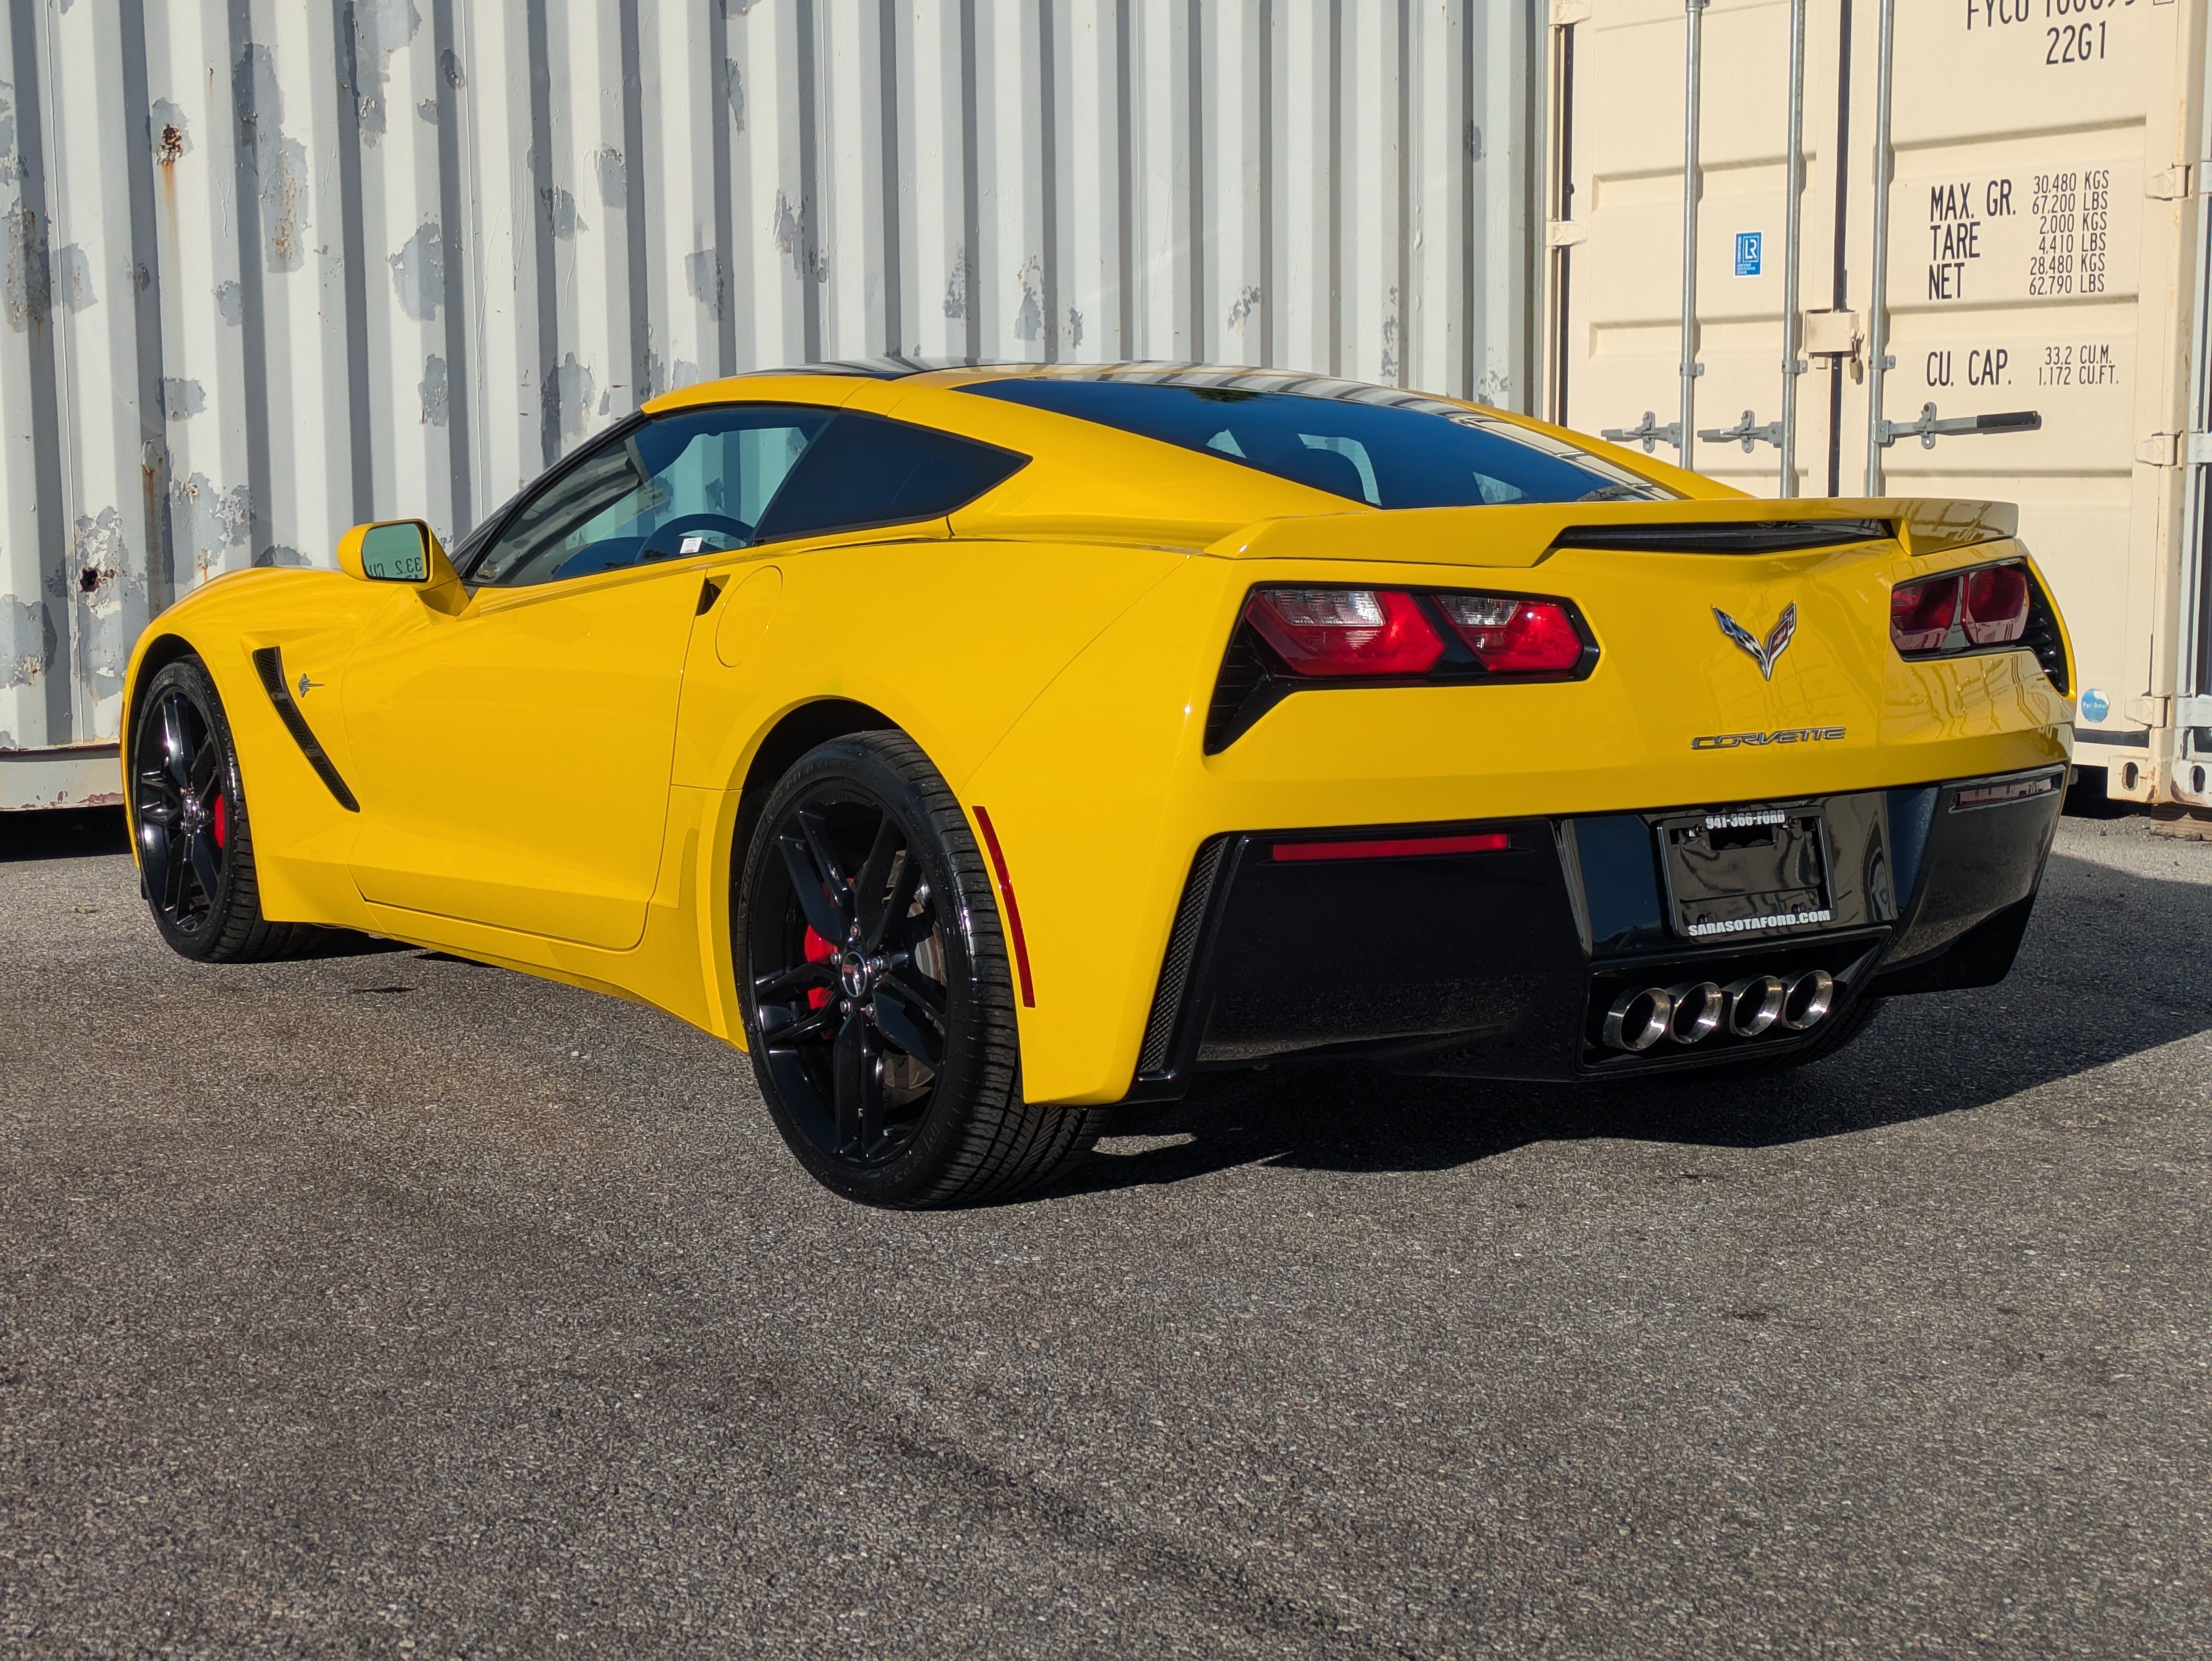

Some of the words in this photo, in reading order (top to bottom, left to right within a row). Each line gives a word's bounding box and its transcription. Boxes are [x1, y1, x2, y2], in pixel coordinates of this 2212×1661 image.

[2046, 20, 2106, 65] 22G1
[2084, 170, 2109, 190] KGS
[1931, 182, 1974, 222] MAX.
[1987, 179, 2016, 216] GR.
[2083, 191, 2108, 211] LBS
[2082, 211, 2107, 232] KGS
[1745, 239, 1757, 259] LR
[1930, 221, 1980, 261] TARE
[2081, 232, 2106, 252] LBS
[2081, 253, 2105, 273] KGS
[1929, 262, 1965, 300] NET
[2080, 273, 2104, 293] LBS
[2045, 346, 2072, 365] 33.2
[2080, 344, 2112, 364] CU.M.
[1927, 351, 1954, 387] CU.
[1969, 349, 2011, 386] CAP.
[2079, 365, 2119, 384] CU.FT.
[1691, 727, 1846, 750] CORVETTE
[1705, 809, 1785, 830] 941-366-FORD
[1688, 910, 1831, 936] SARASOTAFORD.COM
